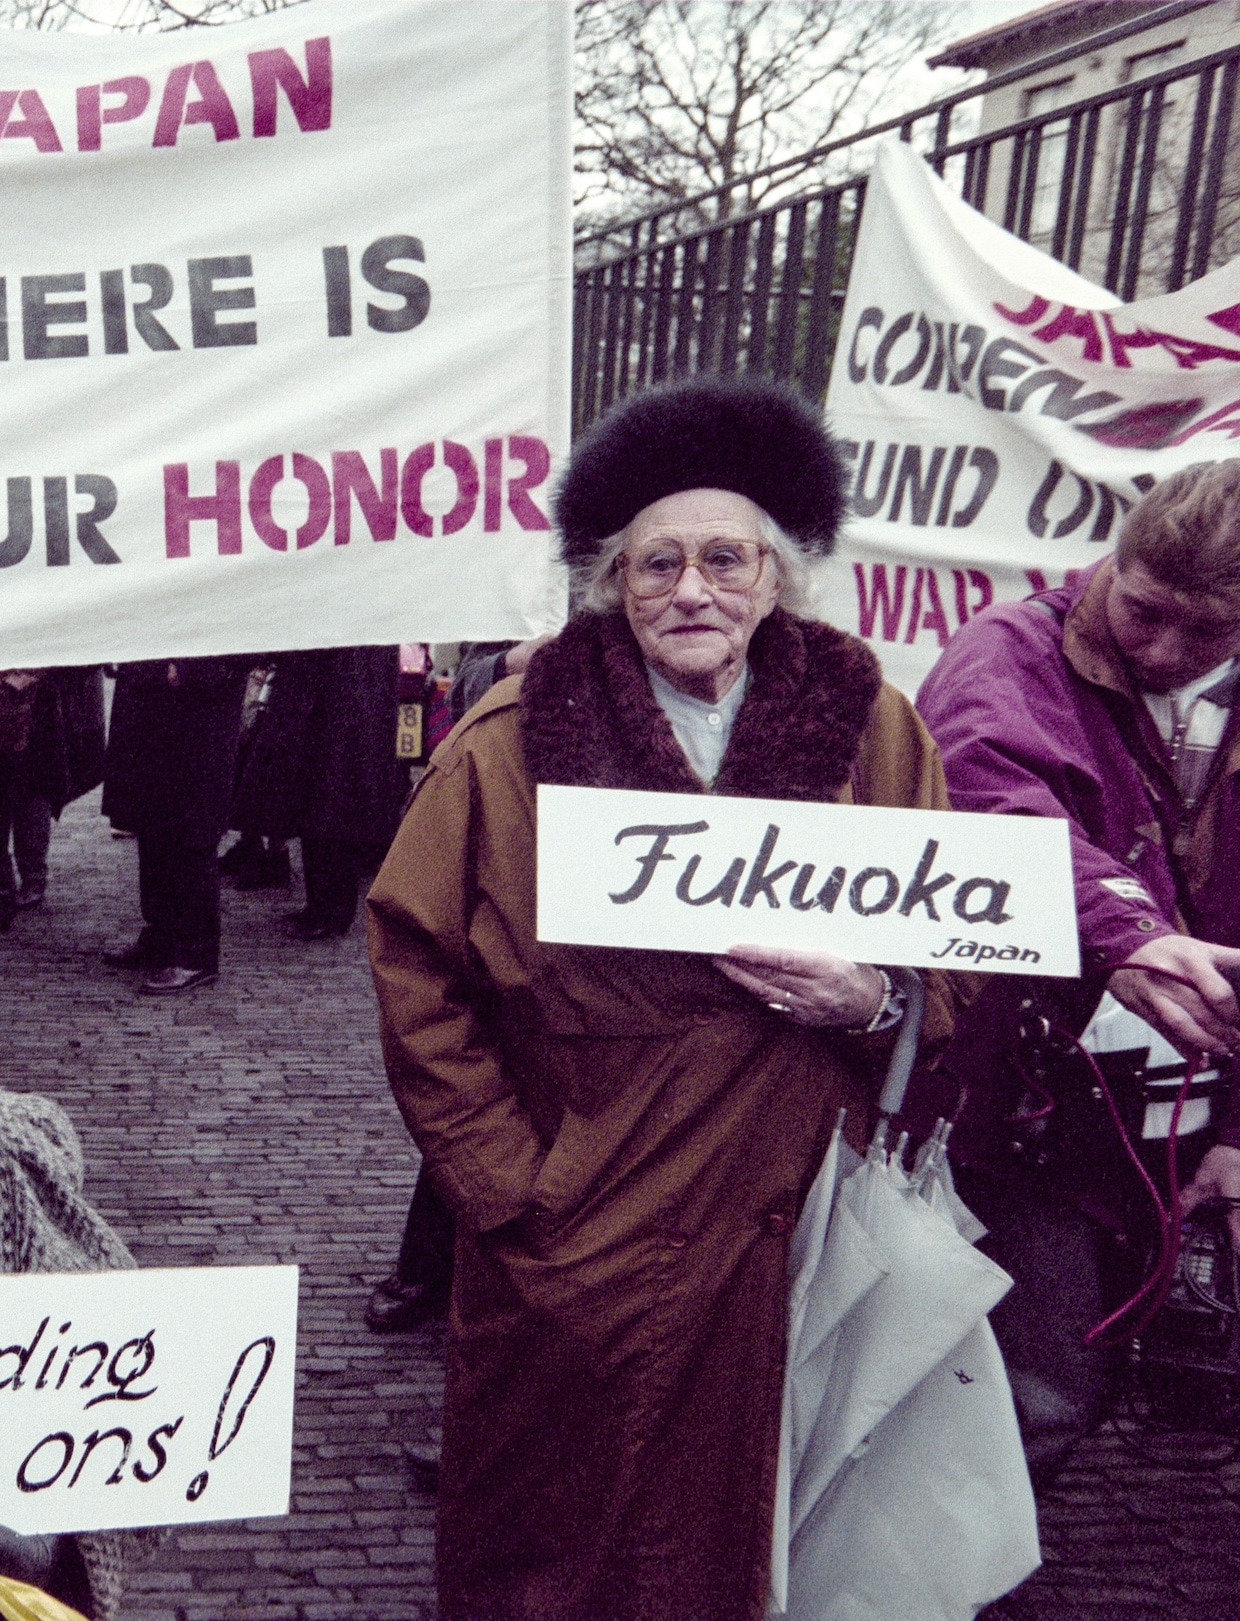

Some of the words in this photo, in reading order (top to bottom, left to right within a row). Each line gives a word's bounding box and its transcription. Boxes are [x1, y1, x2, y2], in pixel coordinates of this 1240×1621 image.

[323, 235, 432, 338] IS
[163, 435, 553, 558] HONOR
[608, 820, 1014, 926] Fukuoka
[930, 937, 1042, 964] Japan
